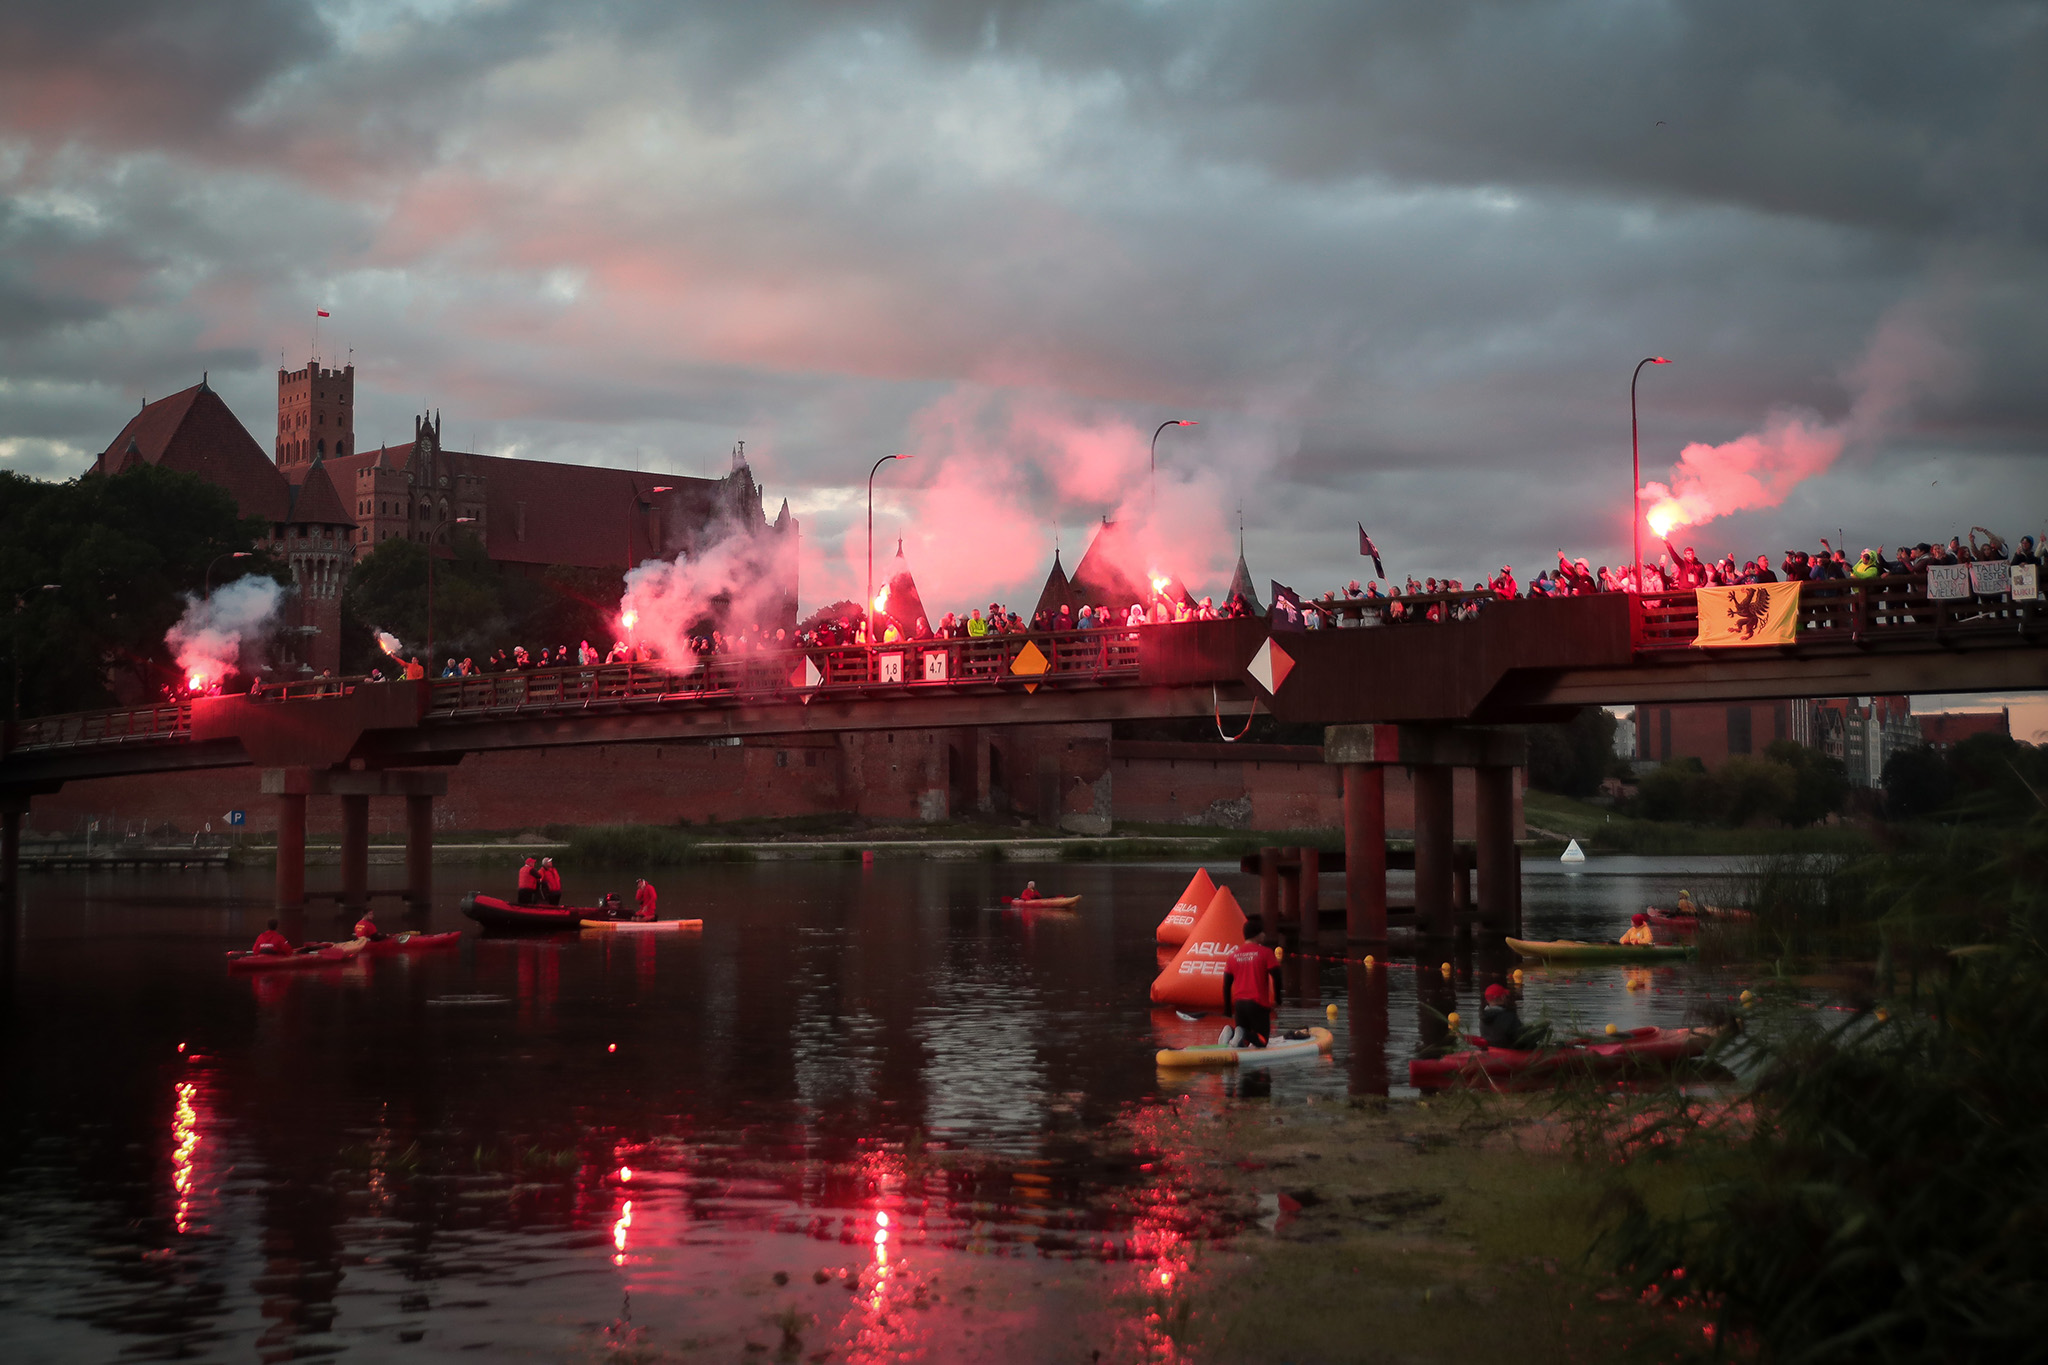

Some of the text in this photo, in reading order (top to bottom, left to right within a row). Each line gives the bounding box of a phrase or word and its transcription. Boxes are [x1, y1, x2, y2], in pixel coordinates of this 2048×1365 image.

[885, 663, 898, 675] 1.8
[929, 661, 942, 674] 4.7
[234, 812, 242, 823] P
[1164, 915, 1194, 925] SPEED
[1186, 942, 1239, 957] AQUA
[1178, 960, 1227, 975] SPEE
